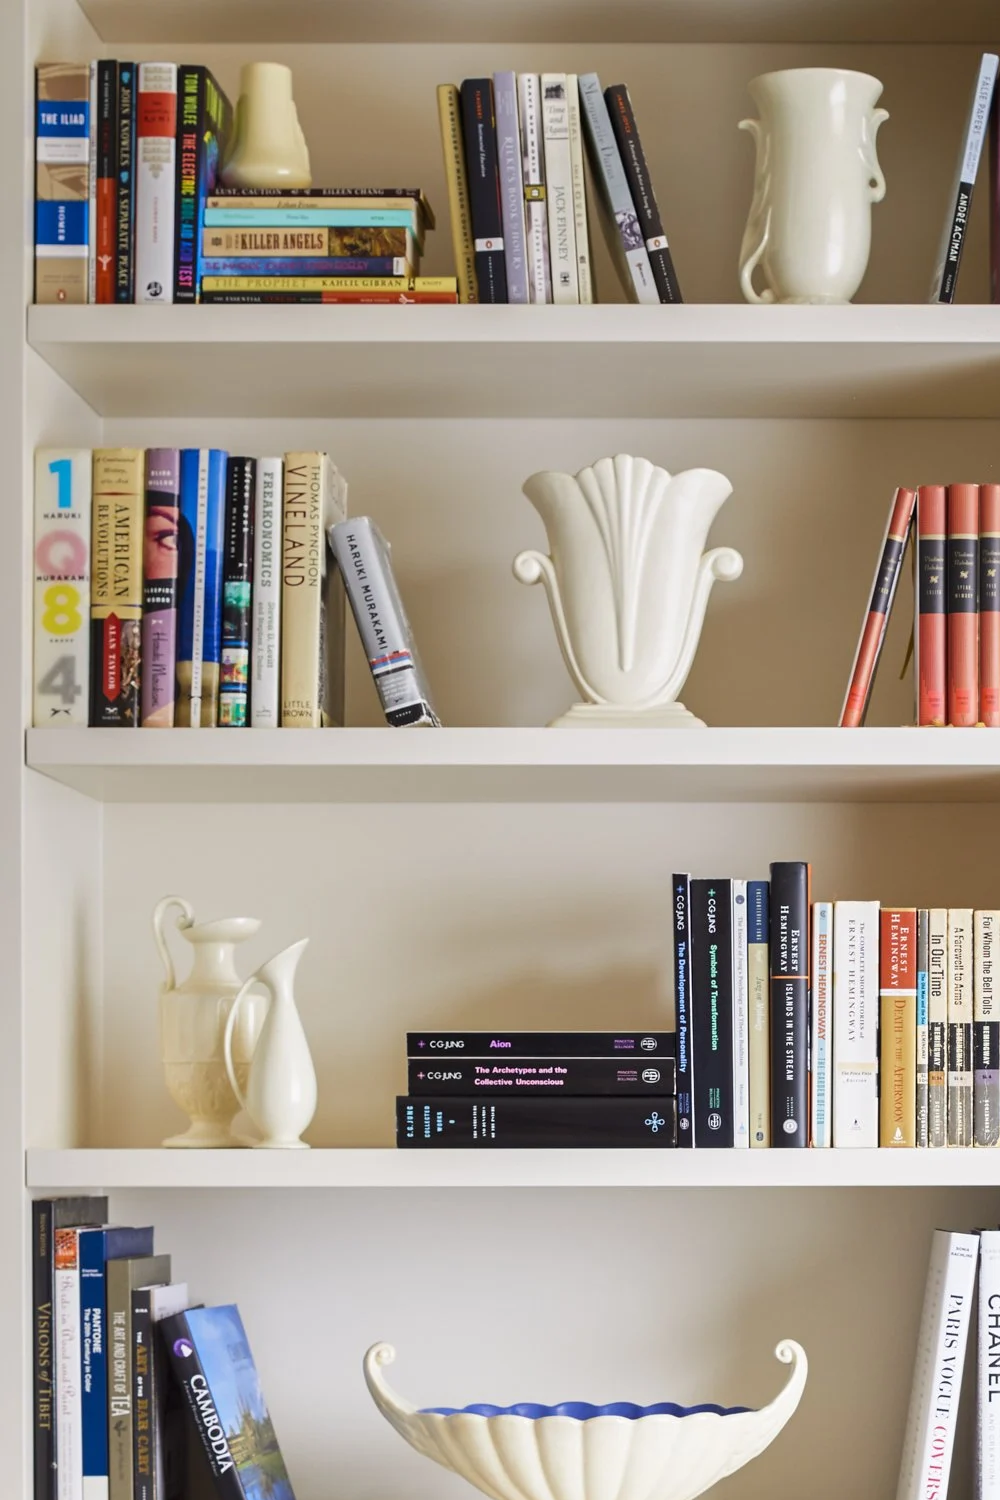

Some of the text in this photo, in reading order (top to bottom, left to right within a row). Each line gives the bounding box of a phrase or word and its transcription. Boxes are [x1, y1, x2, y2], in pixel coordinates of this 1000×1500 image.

[183, 73, 198, 125] TOM WOLFE
[979, 76, 992, 101] FALSE
[41, 113, 85, 125] THE ILIAD
[120, 86, 131, 166] JOHN KNOWLES
[478, 123, 487, 152] Sentimental
[972, 103, 988, 135] PAPERS
[479, 154, 488, 178] Education
[58, 205, 66, 242] HOMER
[179, 133, 196, 287] THE ELECTRIC KOOL-AID ACID TEST
[552, 185, 568, 262] JACK FINNEY
[948, 192, 969, 262] ANDRÉ ACIMAN
[118, 187, 129, 287] A SEPARATE PEACE
[241, 233, 280, 250] KILLER
[282, 233, 323, 250] ANGELS
[96, 504, 109, 598] REVOLUTIONS
[115, 503, 130, 598] AMERICAN
[261, 471, 275, 588] FREAKONOMICS
[283, 465, 307, 588] VINELAND
[308, 465, 320, 588] THOMAS PYNCHON
[346, 534, 389, 651] HARUKI MURAKAMI
[107, 624, 117, 690] ALAN TAYLOR
[283, 701, 311, 709] LITTLE
[283, 710, 313, 718] BROWN
[780, 905, 789, 972] HEMINGWAY
[791, 929, 800, 972] ERNEST
[890, 913, 900, 987] HEMINGWAY
[900, 926, 909, 973] ERNEST
[954, 936, 964, 971] Farewell
[817, 933, 828, 1041] ERNEST HEMINGWAY
[848, 919, 856, 1043] ERNEST HEMINGWAY
[931, 934, 944, 997] In Our Time
[954, 973, 964, 982] to
[981, 916, 993, 1015] For Whom the Bell Tolls
[677, 941, 688, 1073] The Development of Personality
[709, 944, 719, 1050] Symbols of Transformation
[894, 999, 906, 1033] DEATH
[954, 983, 964, 1006] Arms
[489, 1039, 512, 1048] Aion
[785, 983, 794, 1081] ISLANDS IN THE STREAM
[895, 1037, 902, 1045] IN
[933, 1026, 941, 1066] HEMINGWAY
[982, 1025, 990, 1065] HEMINGWAY
[474, 1066, 568, 1075] The Archetypes and the
[474, 1078, 564, 1086] Collective Unconscious
[816, 1057, 826, 1125] THE GARDEN OF EDEN
[894, 1064, 906, 1123] AFTERNOON
[83, 1338, 92, 1366] Century
[92, 1308, 102, 1353] PANTONE
[37, 1302, 52, 1430] VISIONS of TIBET
[84, 1374, 92, 1393] Color
[111, 1311, 131, 1417] THE ART AND CRAFT OF TEA
[136, 1344, 148, 1375] ART
[137, 1376, 143, 1384] OF
[137, 1399, 149, 1431] BAR
[925, 1294, 964, 1500] PARIS VOGUE COVERS
[190, 1374, 234, 1474] CAMBODIA
[137, 1435, 149, 1476] CART
